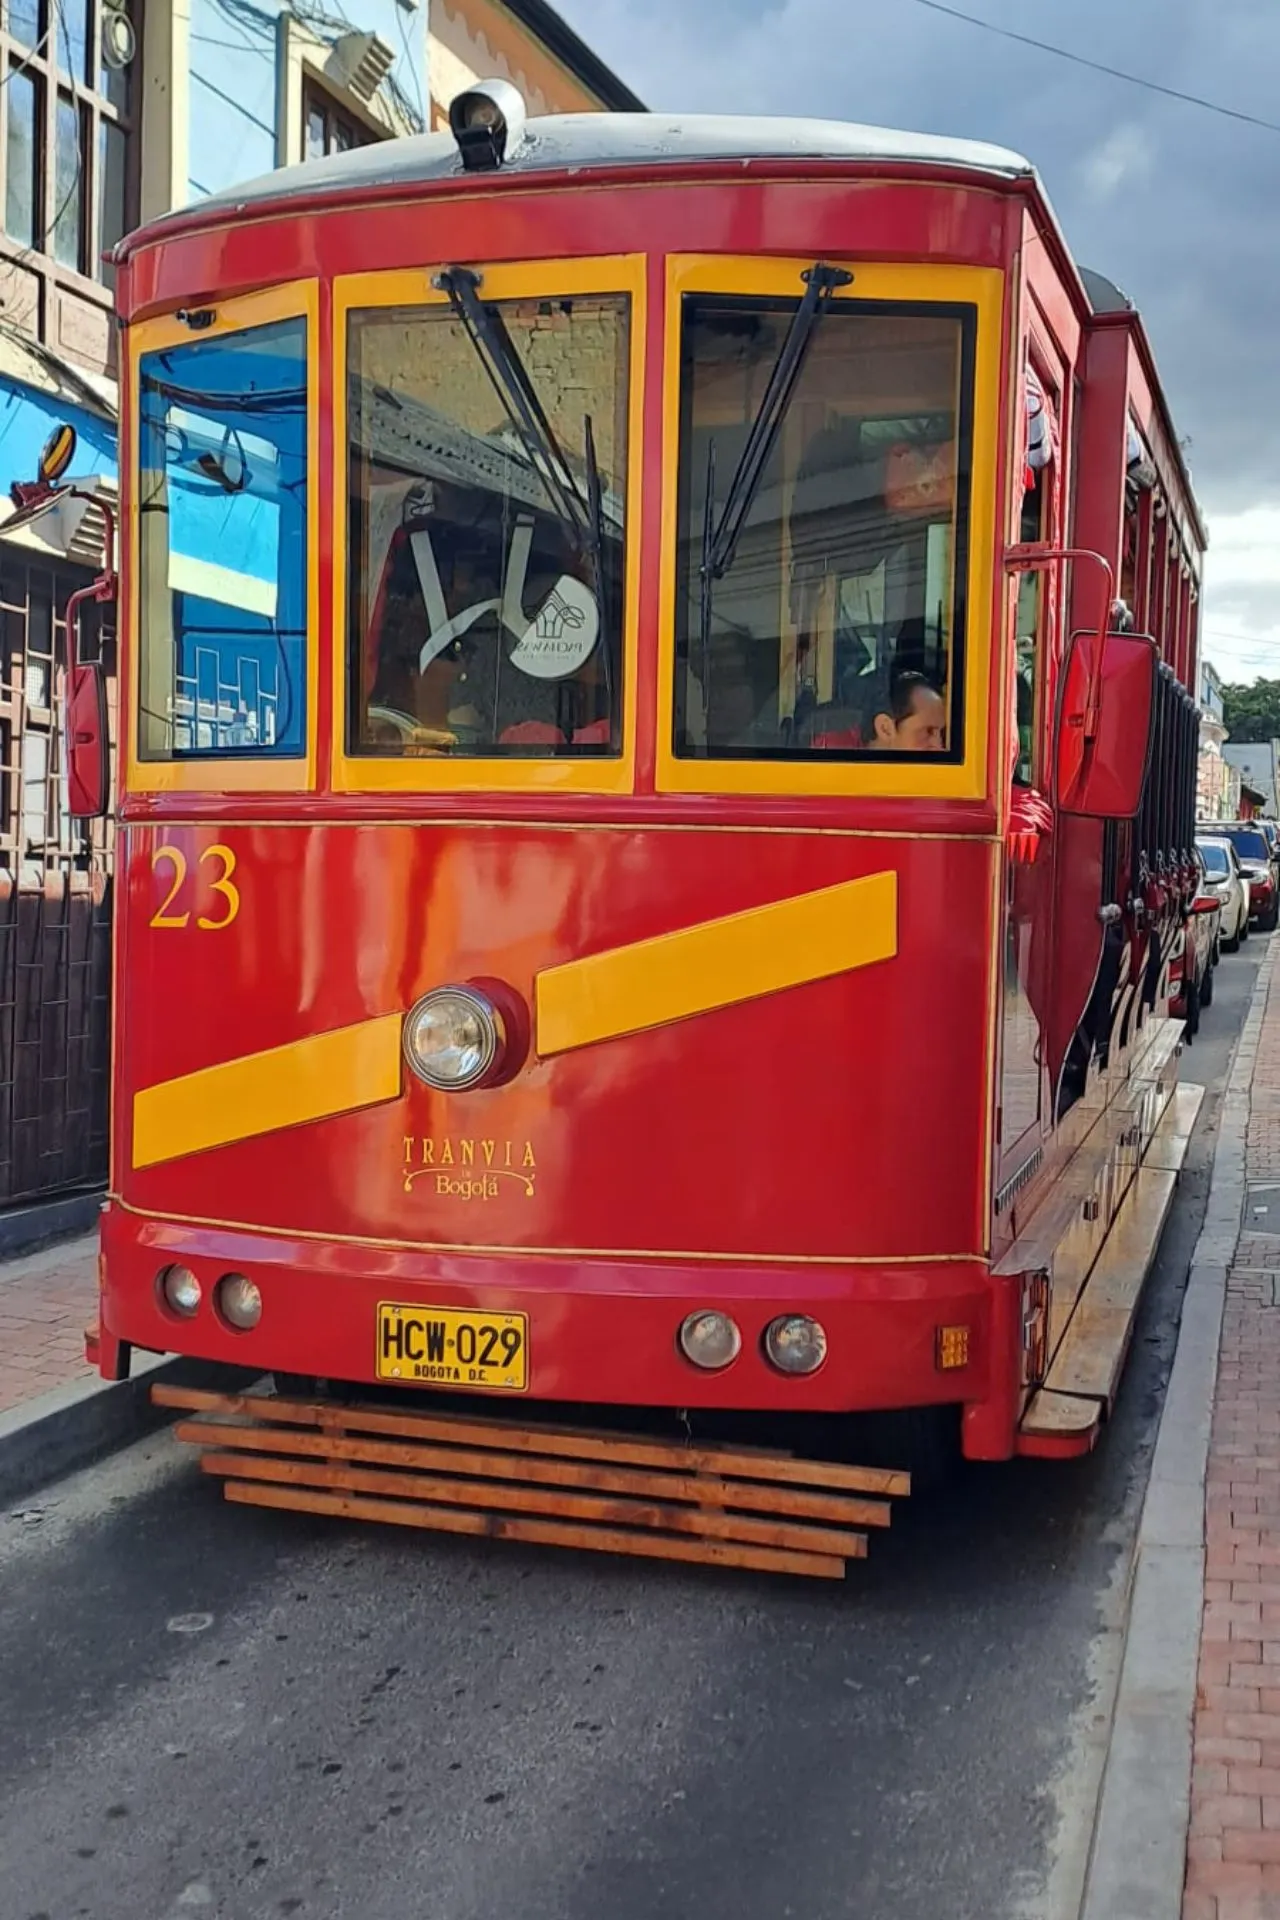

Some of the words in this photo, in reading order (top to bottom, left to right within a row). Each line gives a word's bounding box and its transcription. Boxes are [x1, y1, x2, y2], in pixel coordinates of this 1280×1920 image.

[149, 844, 240, 930] 23
[403, 1136, 536, 1167] TRANVIA
[414, 1363, 460, 1380] BOGOTA
